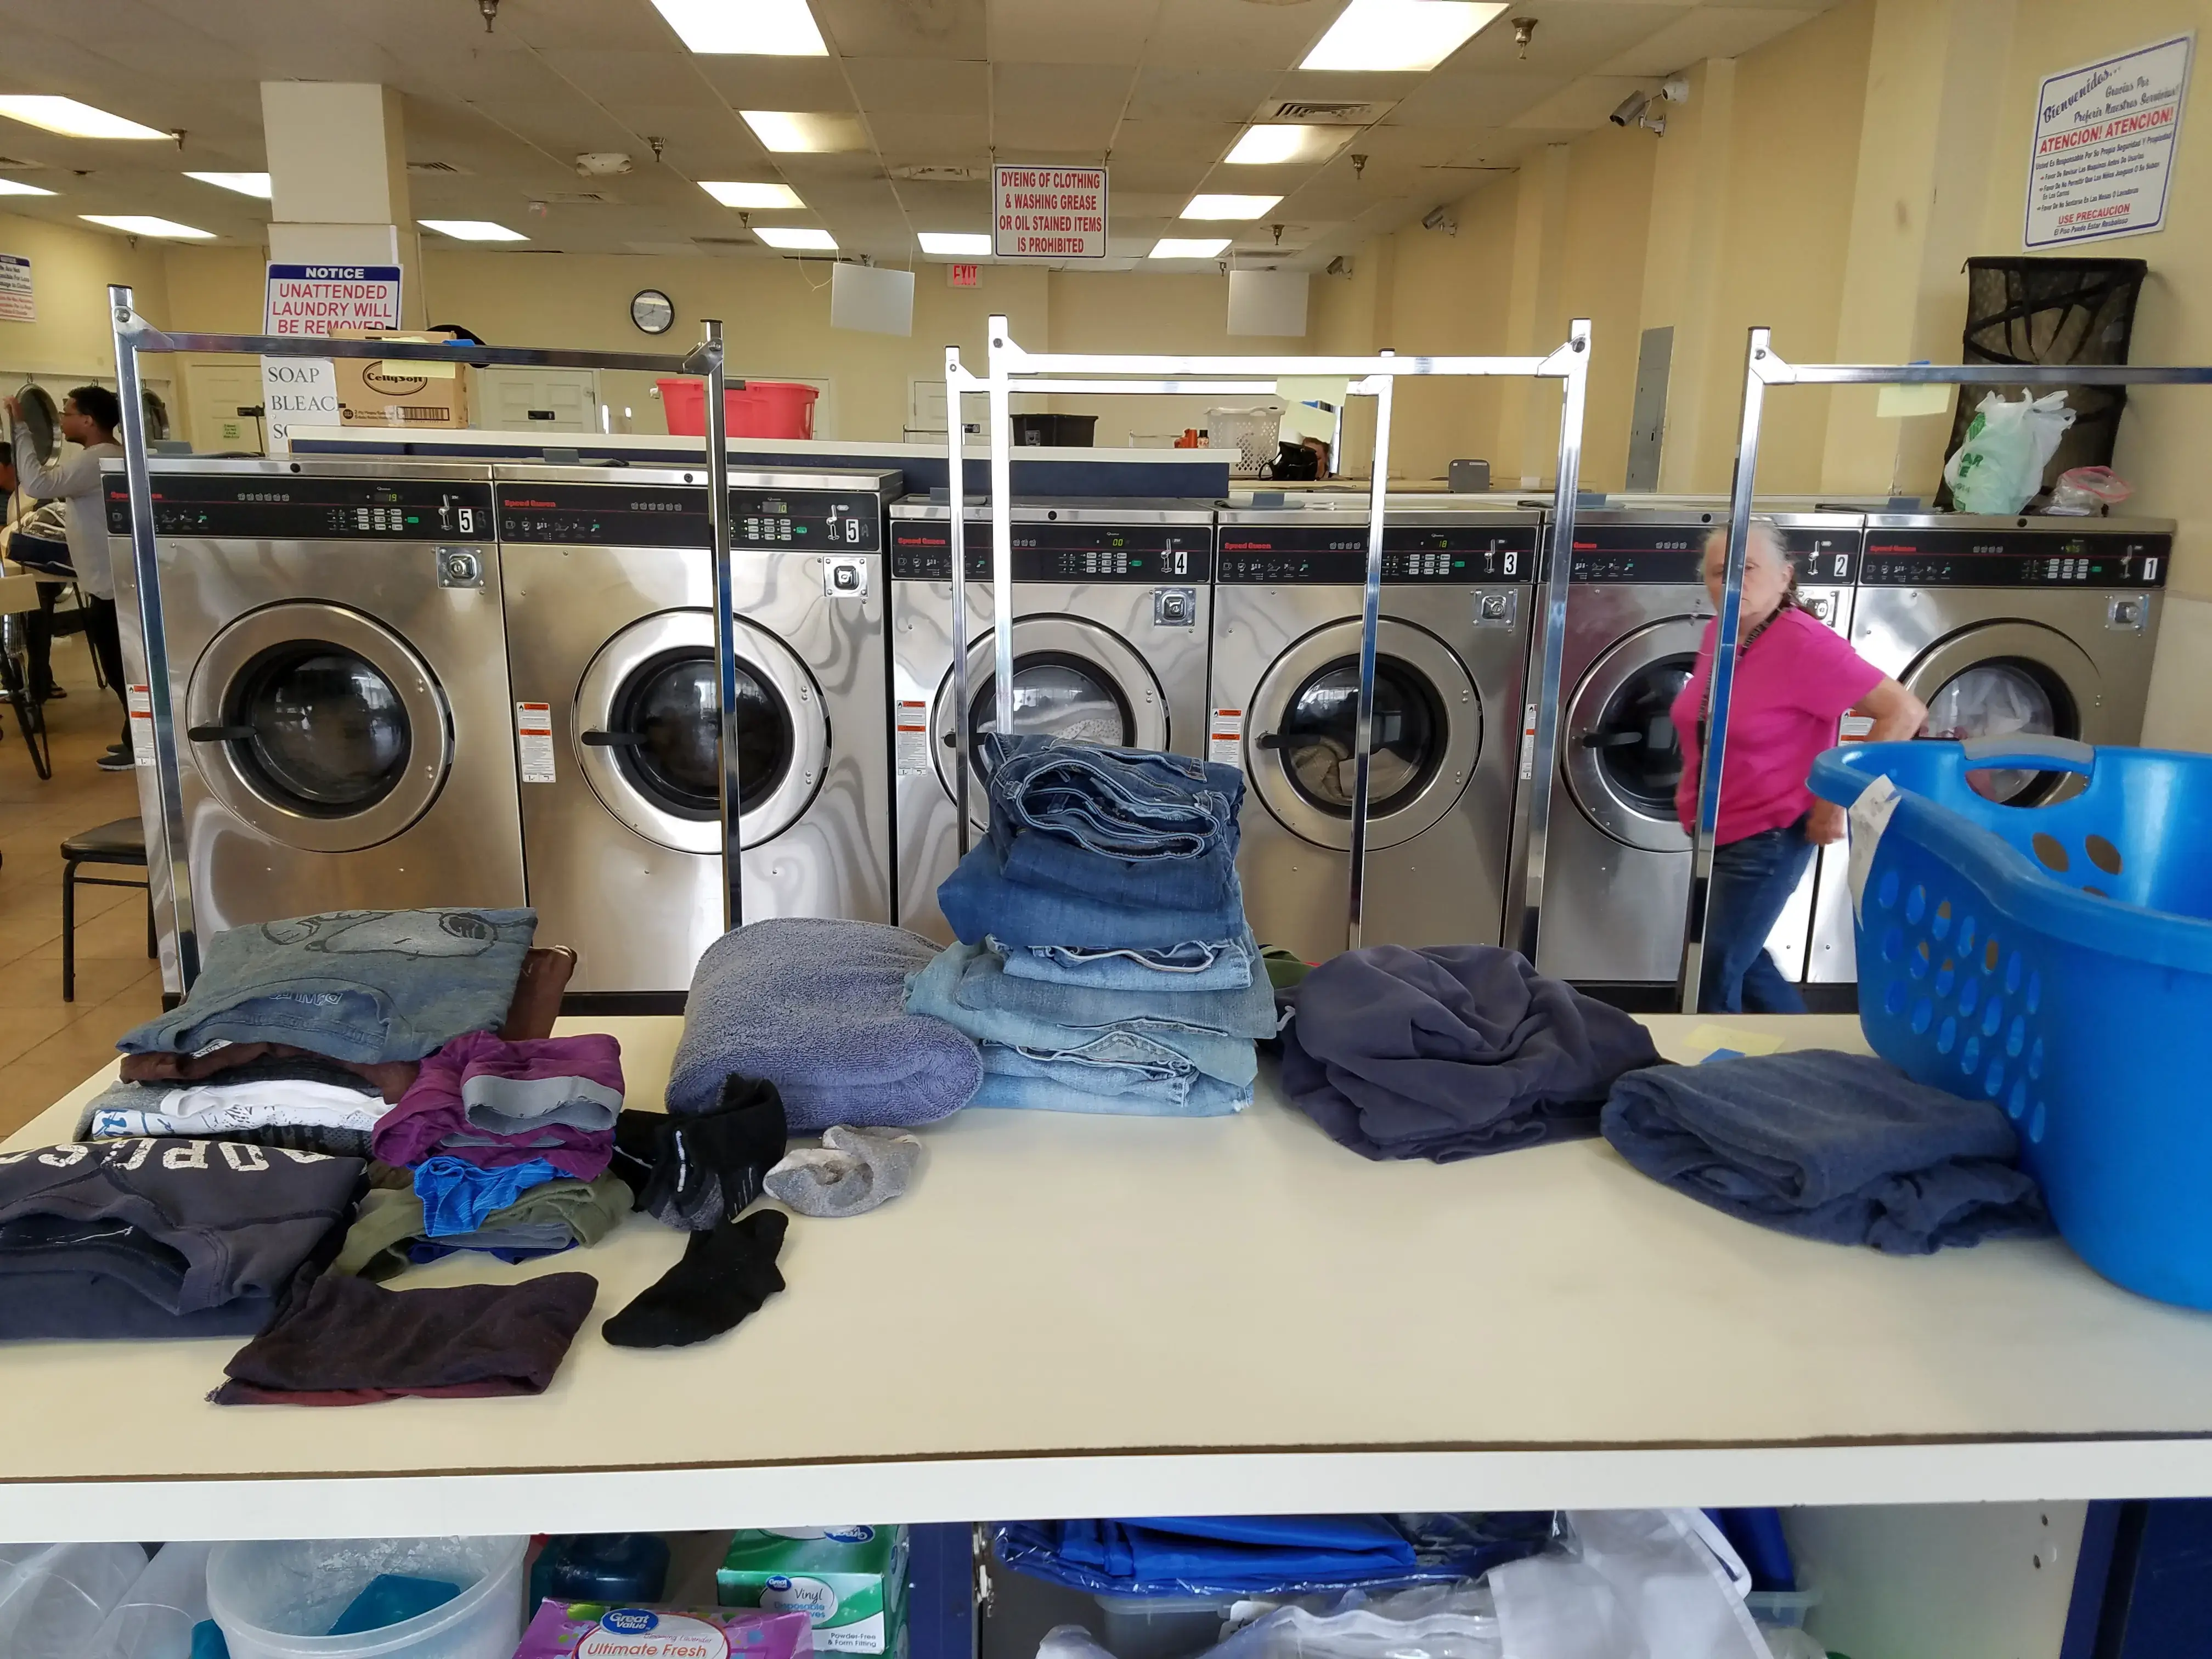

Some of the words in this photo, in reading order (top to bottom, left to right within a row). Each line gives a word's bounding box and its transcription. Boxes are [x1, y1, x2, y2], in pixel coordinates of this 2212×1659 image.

[2039, 125, 2103, 154] ATENCION!
[2105, 106, 2174, 138] ATENCION!
[1001, 171, 1036, 188] DYEING
[1039, 172, 1051, 188] OF
[1053, 172, 1100, 189] CLOTHING
[1005, 193, 1012, 209] &
[1014, 193, 1058, 210] WASHING
[1060, 194, 1097, 211] GREASE
[2058, 213, 2074, 224] USE
[2076, 203, 2130, 222] PRECAUCION
[1000, 215, 1012, 230] OR
[1015, 215, 1030, 230] OIL
[1032, 216, 1071, 232] STAINED
[1074, 216, 1102, 232] ITEMS
[1018, 237, 1026, 252] IS
[1029, 237, 1084, 253] PROHIBITED
[306, 267, 365, 279] NOTICE
[953, 265, 978, 285] EXIT
[279, 283, 387, 299] UNATTENDED
[272, 301, 349, 317] LAUNDRY
[354, 303, 392, 317] WILL
[278, 319, 299, 334] BE
[268, 367, 320, 383] SOAP
[272, 396, 338, 411] BLEAC
[461, 511, 470, 531] 5
[848, 521, 856, 540] 5
[1177, 554, 1185, 573] 4
[1506, 554, 1514, 573] 3
[1836, 556, 1846, 575] 2
[2148, 559, 2155, 579] 1
[794, 1588, 823, 1604] Vinyl
[774, 1601, 825, 1611] Disposable
[609, 1612, 650, 1623] Great
[616, 1621, 646, 1629] Value
[588, 1643, 657, 1656] Ultimate
[663, 1644, 707, 1657] Fresh
